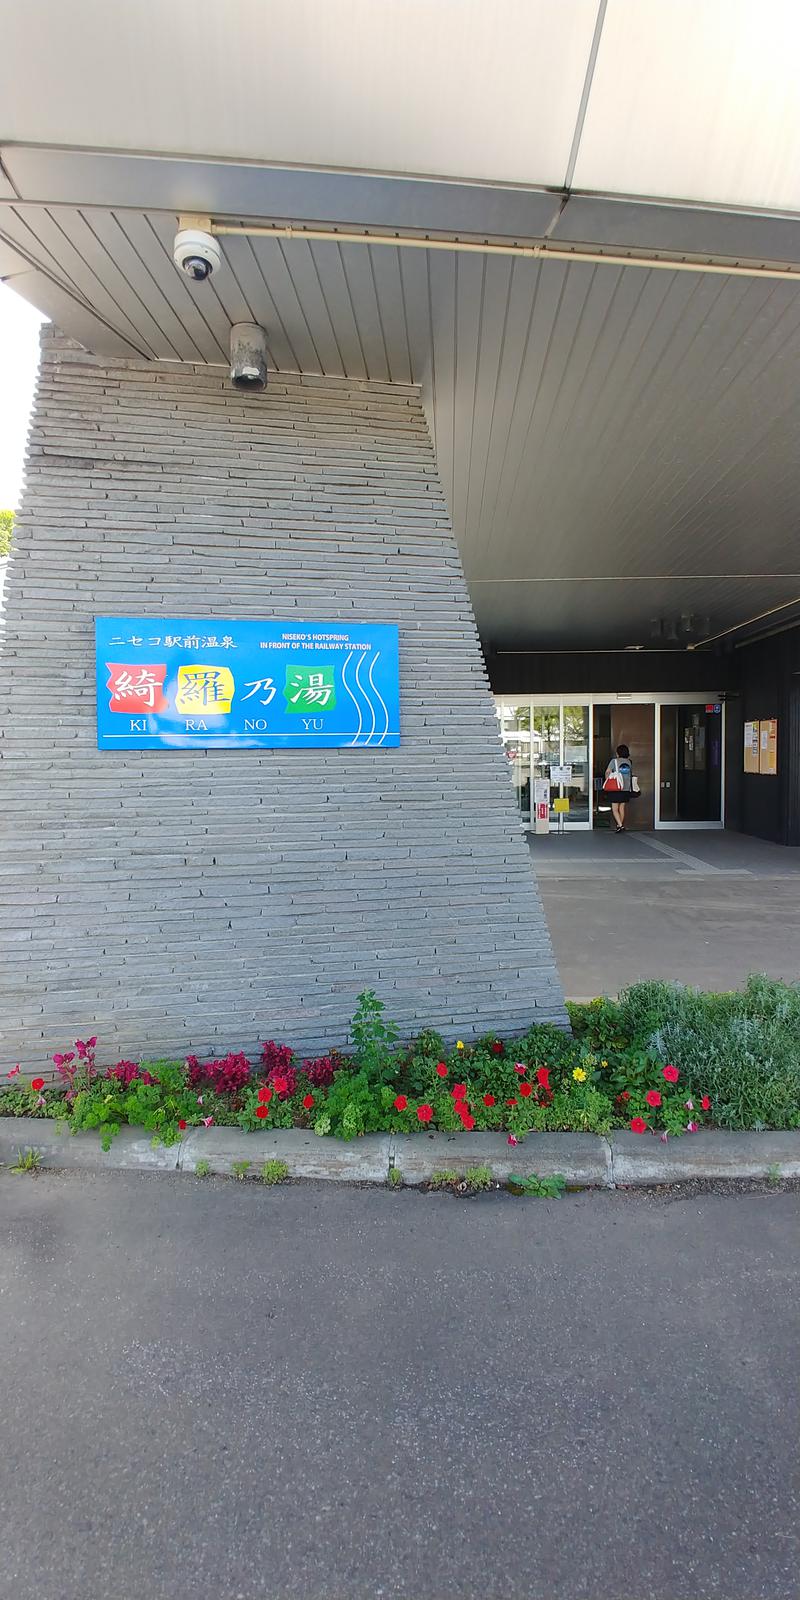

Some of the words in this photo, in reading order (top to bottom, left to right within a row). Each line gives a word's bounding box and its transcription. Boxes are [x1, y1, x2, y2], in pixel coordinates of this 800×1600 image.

[108, 634, 238, 650] ニセコ駅前温泉
[282, 633, 312, 641] NISEKO'S
[113, 670, 334, 707] 綺羅乃湯
[130, 719, 147, 731] KI
[185, 719, 208, 731] RA
[244, 719, 268, 731] NO
[302, 718, 324, 731] YU
